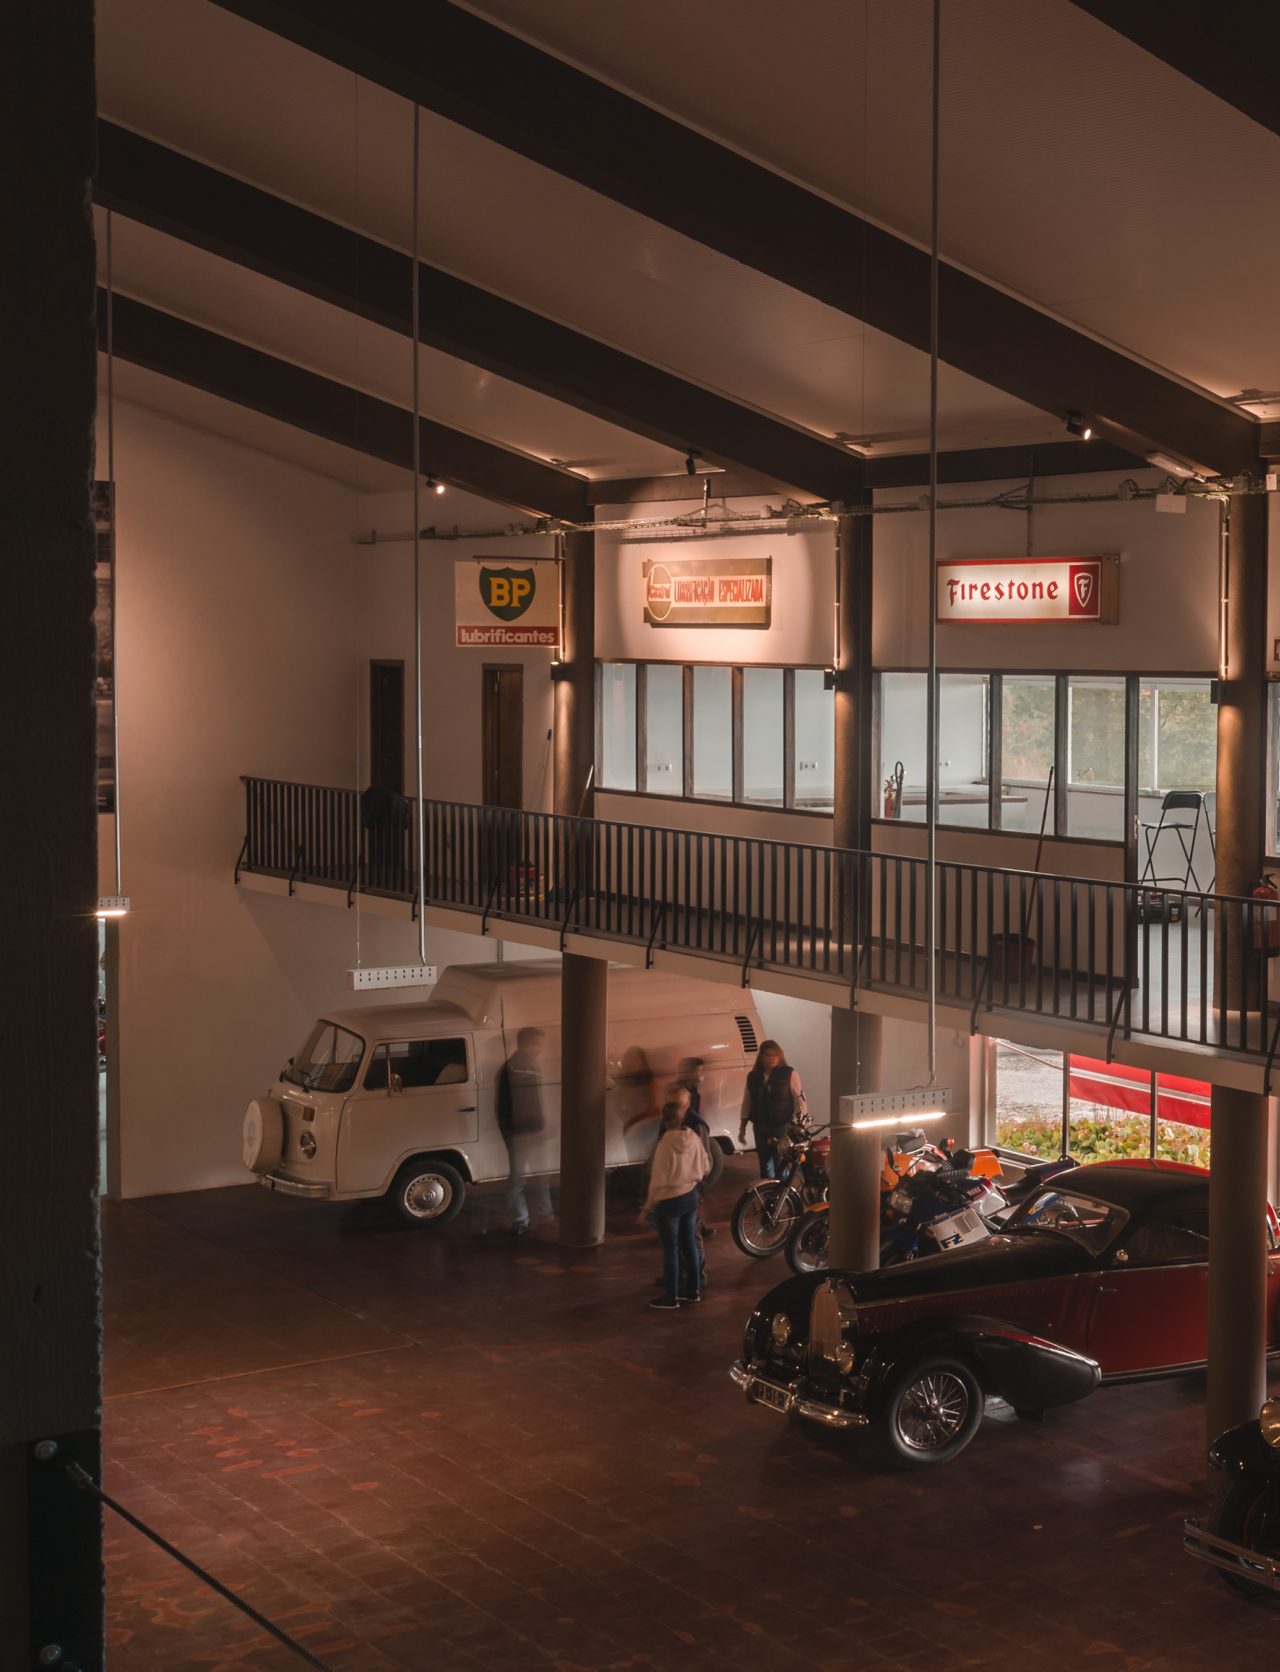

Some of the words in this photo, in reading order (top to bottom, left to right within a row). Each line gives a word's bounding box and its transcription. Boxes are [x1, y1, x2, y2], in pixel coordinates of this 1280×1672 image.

[488, 577, 531, 608] BP
[947, 578, 1059, 607] Firestone
[461, 629, 555, 645] lubrificantes
